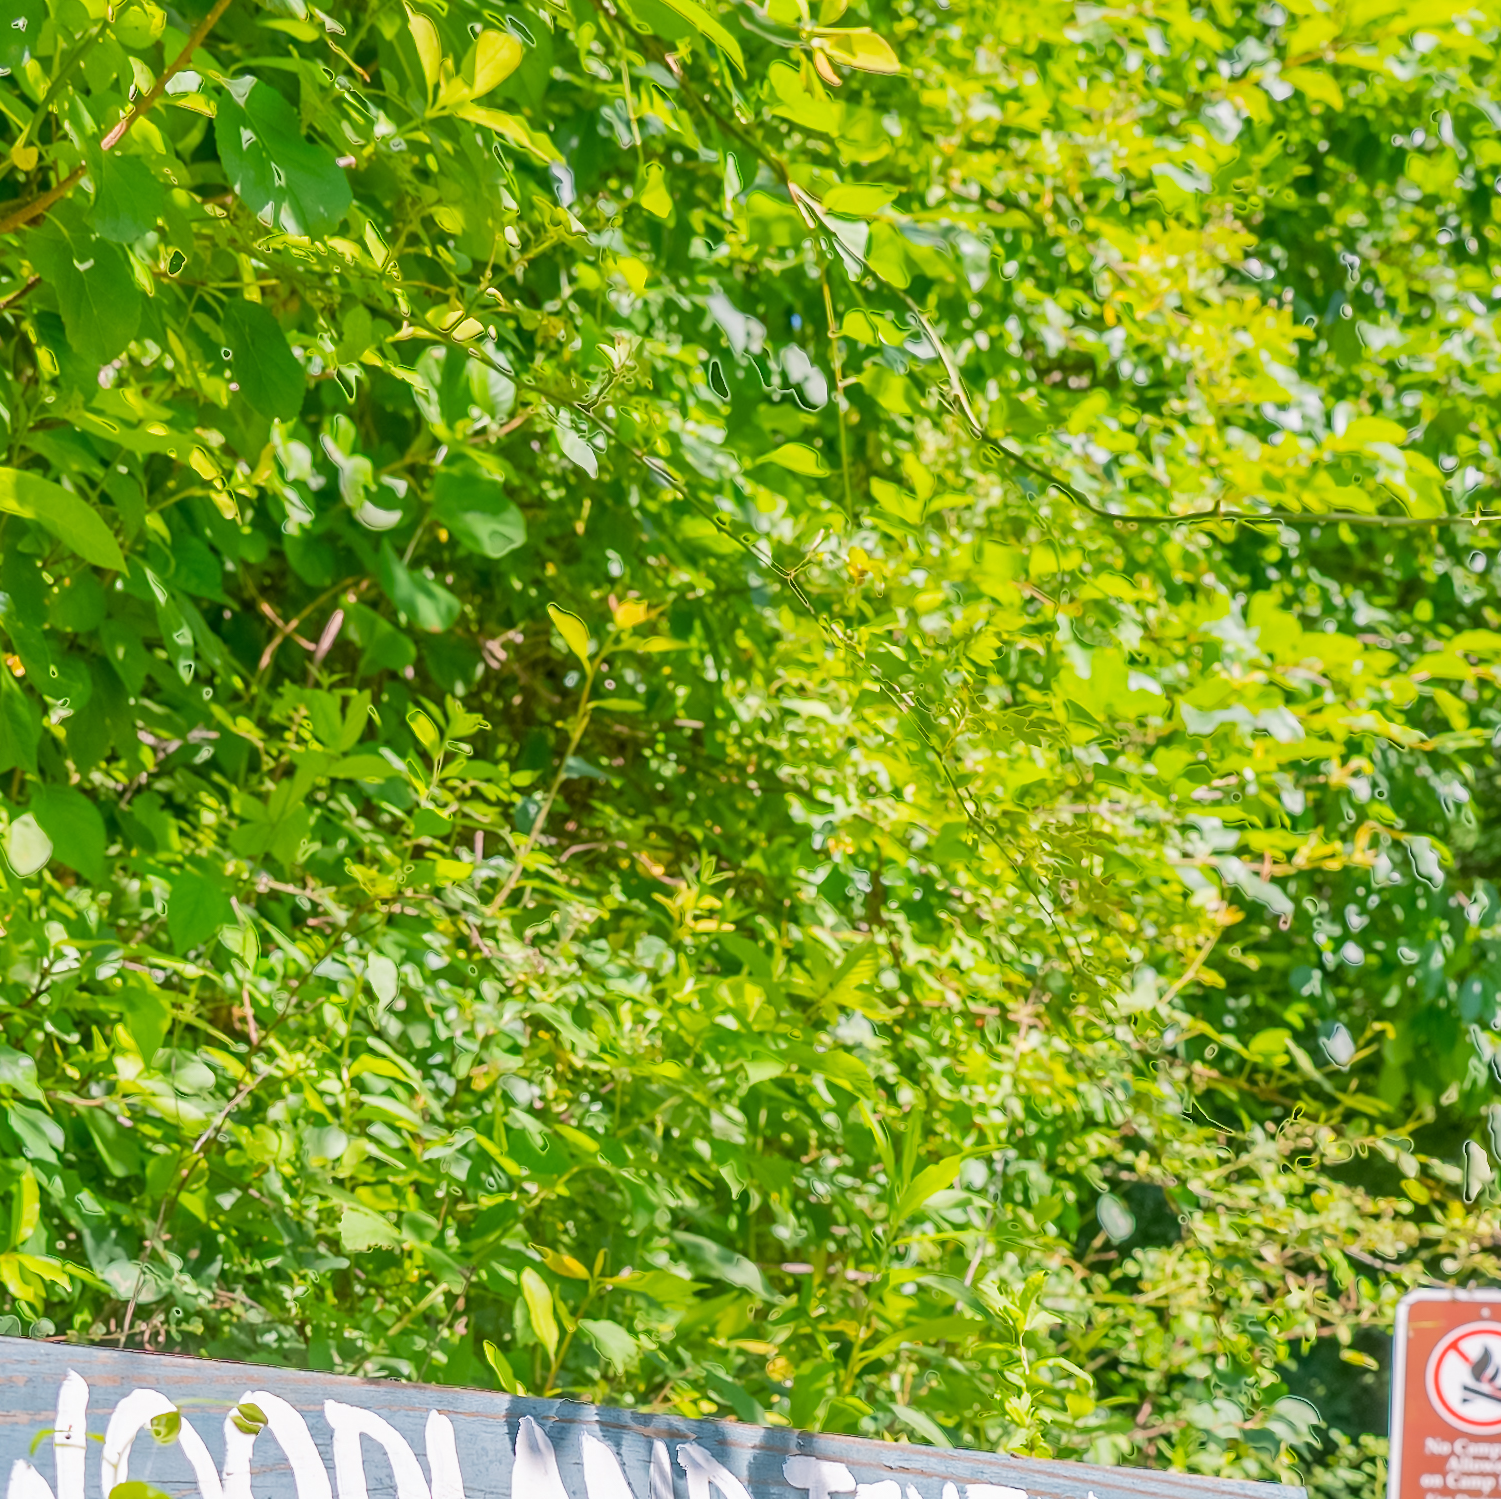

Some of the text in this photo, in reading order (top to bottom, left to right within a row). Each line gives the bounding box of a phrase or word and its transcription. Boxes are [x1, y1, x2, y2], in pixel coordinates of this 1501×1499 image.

[1425, 1437, 1452, 1456] No
[1420, 1473, 1444, 1489] on
[1446, 1472, 1496, 1494] Camp
